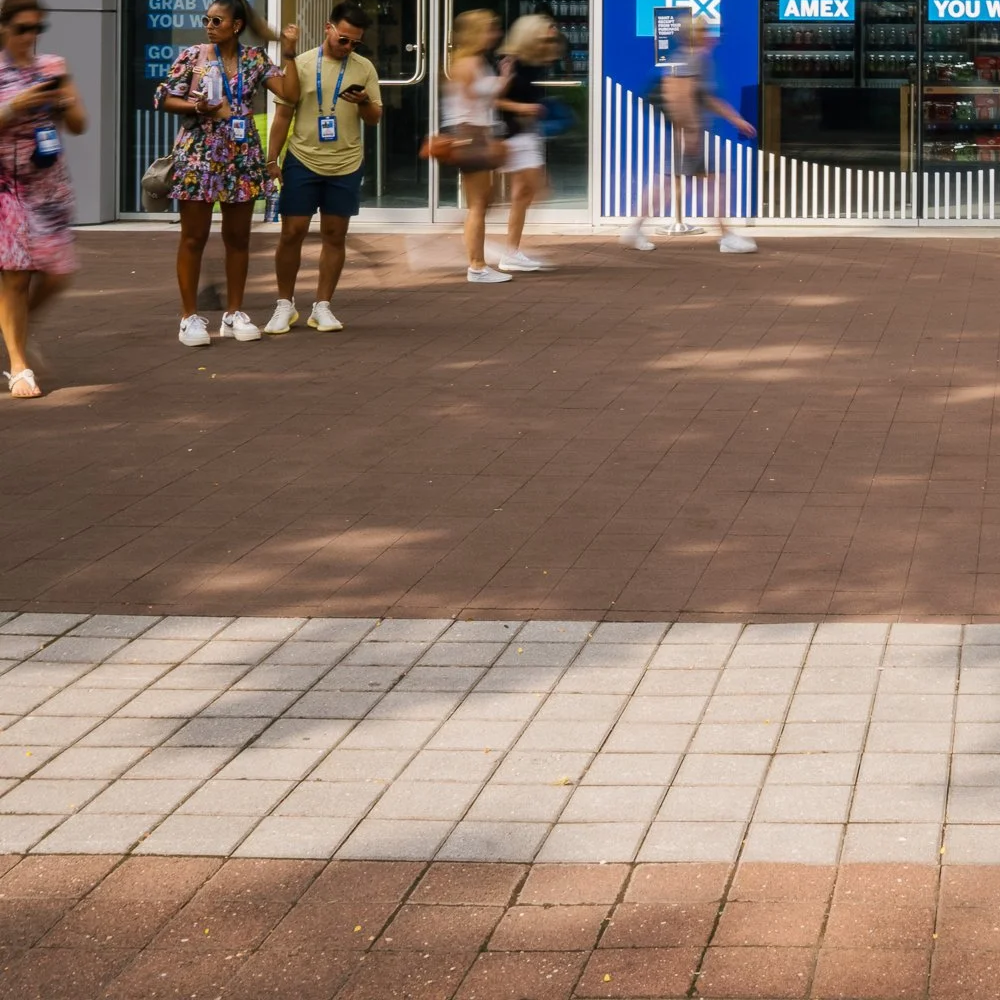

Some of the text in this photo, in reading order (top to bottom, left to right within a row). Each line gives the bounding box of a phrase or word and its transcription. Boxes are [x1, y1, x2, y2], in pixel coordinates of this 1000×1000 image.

[784, 0, 849, 18] AMEX
[933, 0, 981, 18] YOU
[149, 14, 184, 28] YOU
[148, 46, 174, 60] GO
[148, 63, 170, 77] TH
